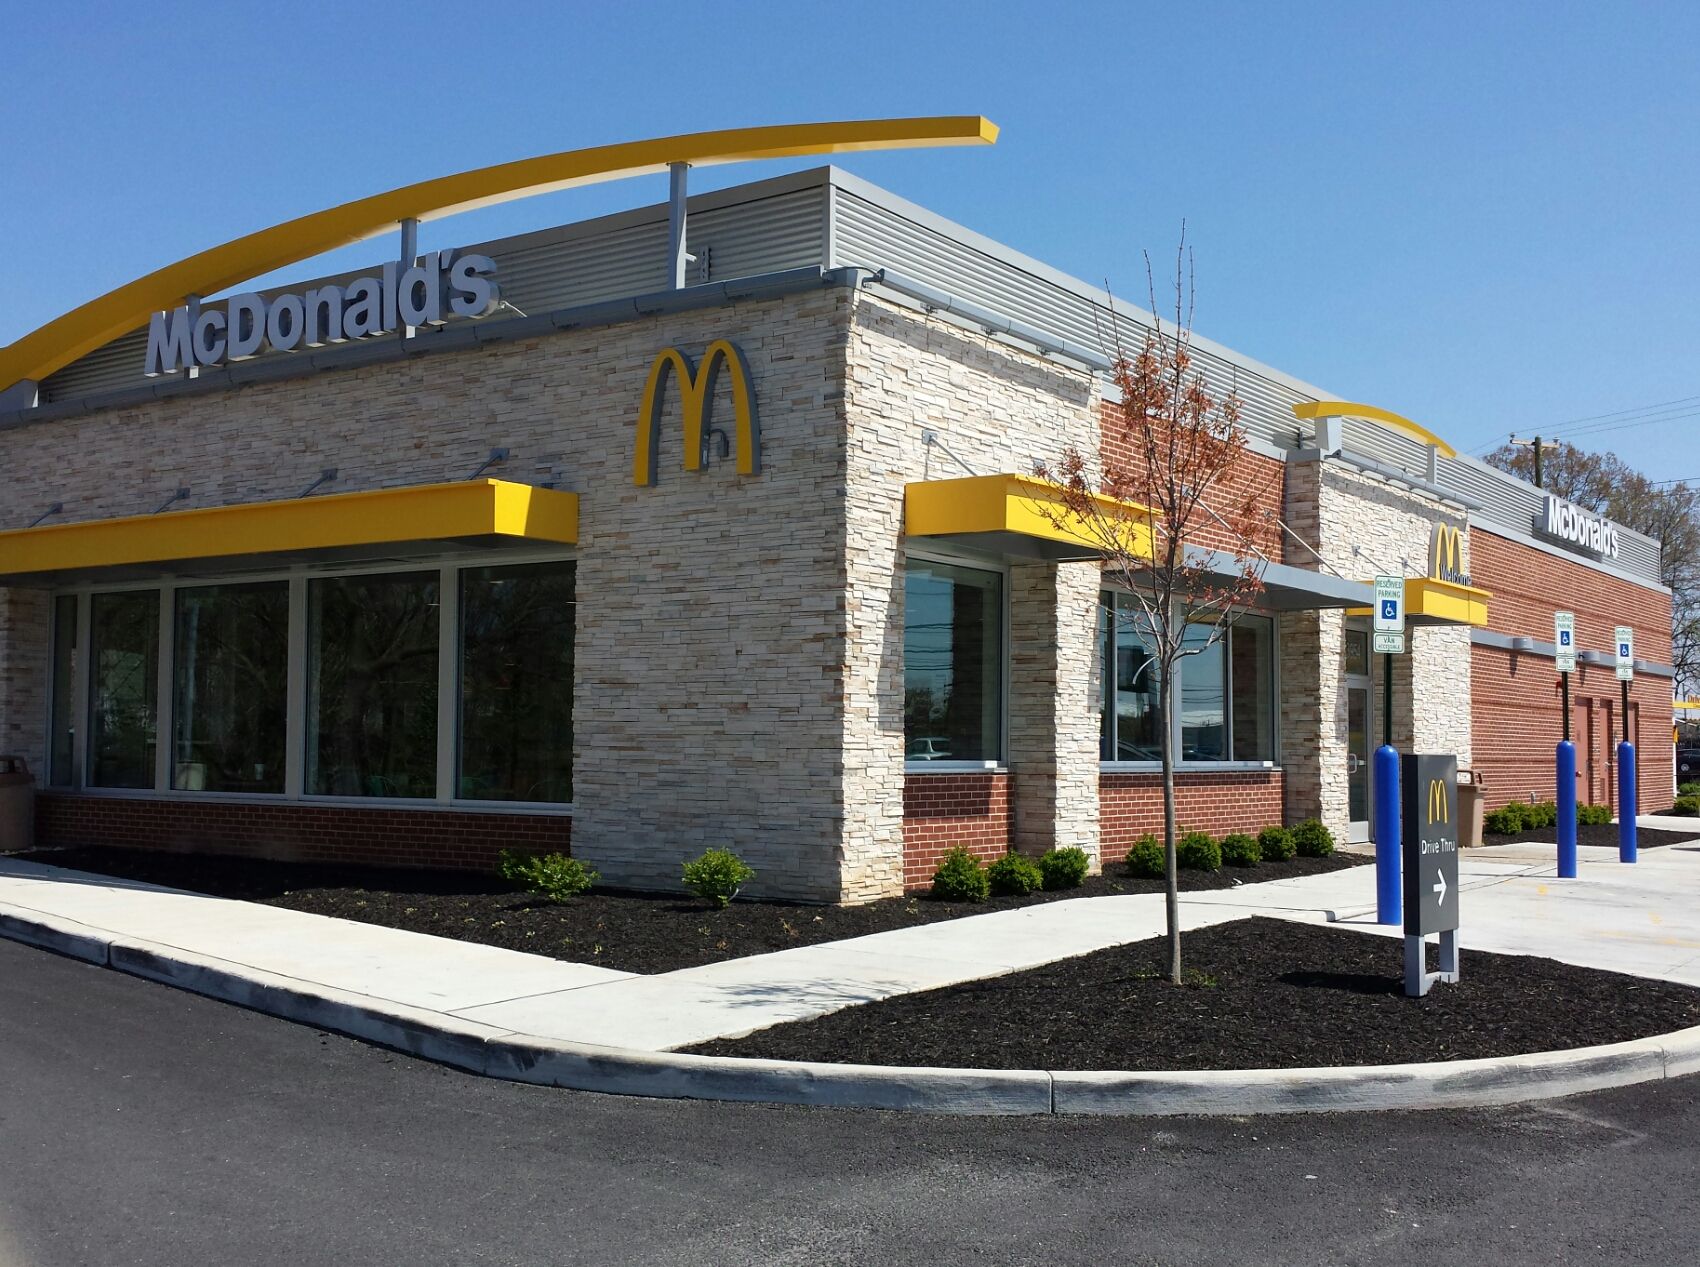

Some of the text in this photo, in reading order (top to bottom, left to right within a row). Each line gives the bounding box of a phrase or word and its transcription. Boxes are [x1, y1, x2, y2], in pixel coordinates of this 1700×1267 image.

[144, 250, 497, 375] McDonald's
[1549, 496, 1618, 559] McDonald's
[1440, 563, 1472, 585] Welcome
[1378, 590, 1401, 598] PARKING
[1422, 837, 1455, 854] Drive Thru
